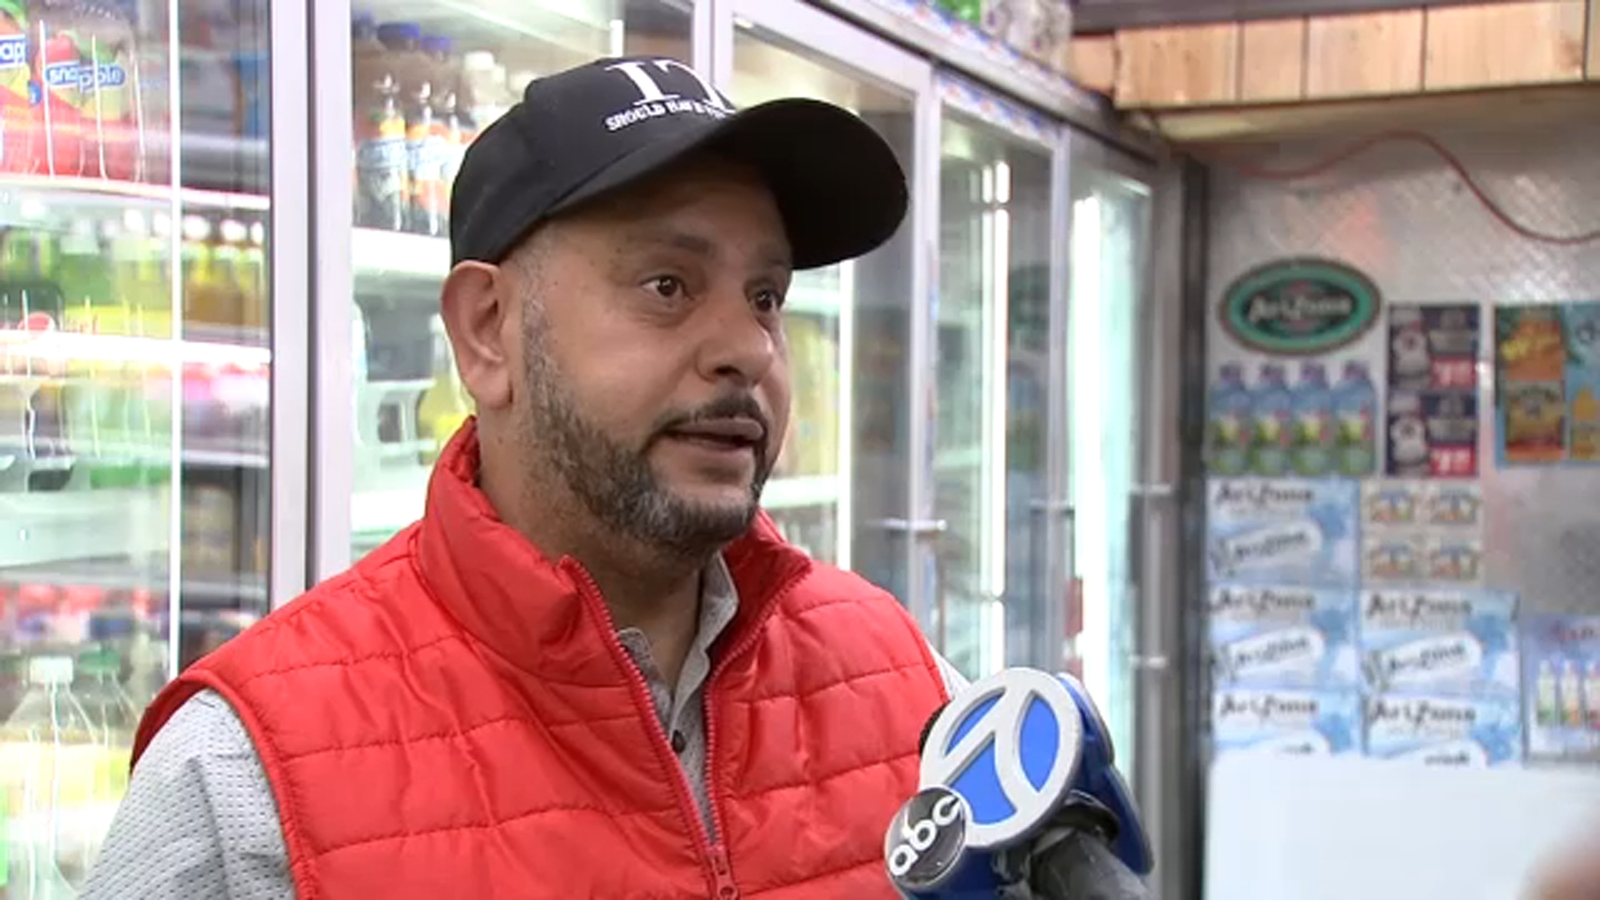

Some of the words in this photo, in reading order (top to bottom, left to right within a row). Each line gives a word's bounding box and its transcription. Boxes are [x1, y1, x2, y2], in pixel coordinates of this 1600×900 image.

[49, 65, 122, 93] snapple
[605, 102, 666, 131] SHOULD
[928, 670, 1060, 830] 7
[888, 793, 961, 877] abc
